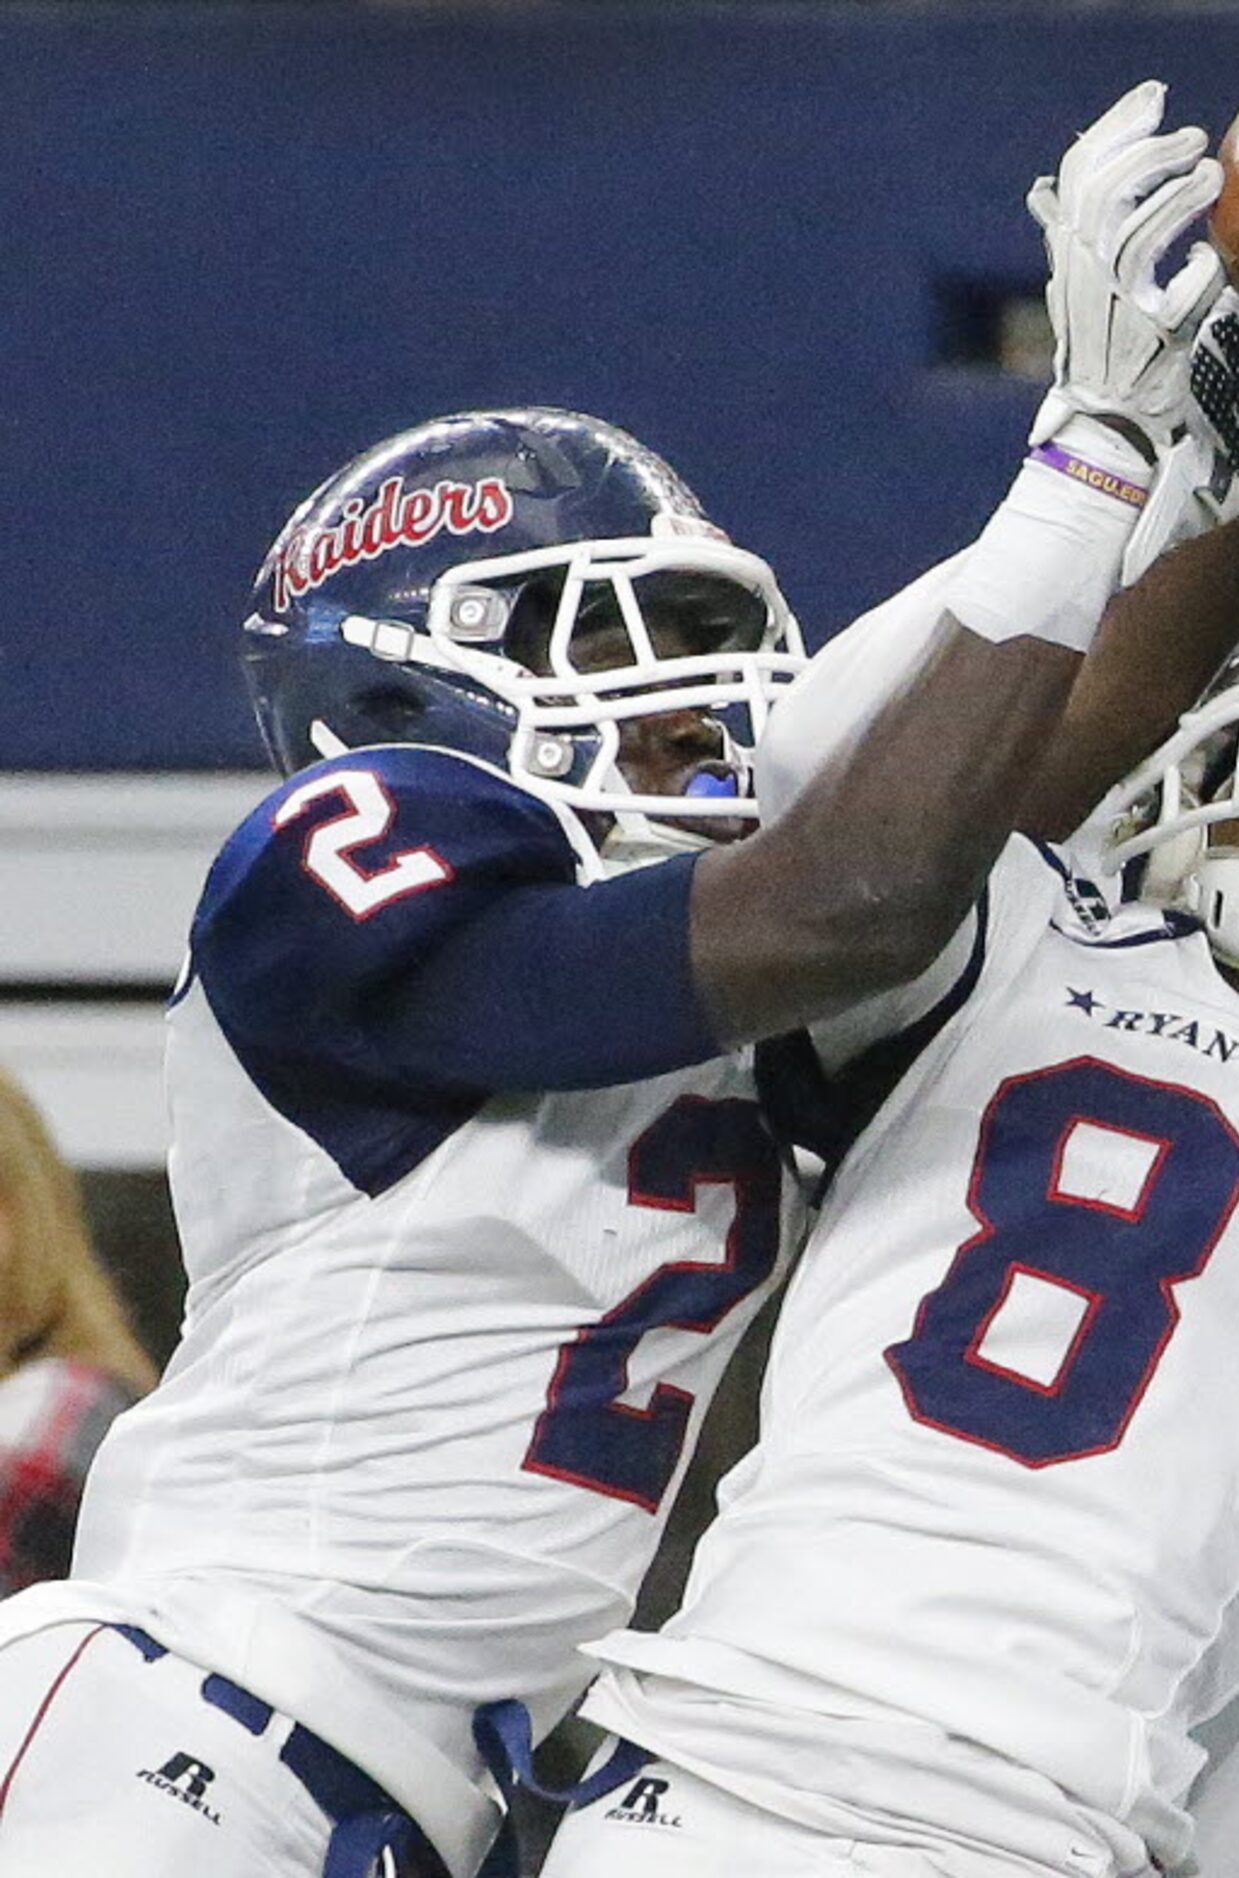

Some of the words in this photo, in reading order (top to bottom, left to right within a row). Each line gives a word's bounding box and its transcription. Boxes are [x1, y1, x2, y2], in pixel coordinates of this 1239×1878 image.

[273, 474, 514, 612] Raiders
[271, 767, 454, 922] 2
[522, 1092, 784, 1515] 2
[135, 1768, 221, 1826] RUSSELL
